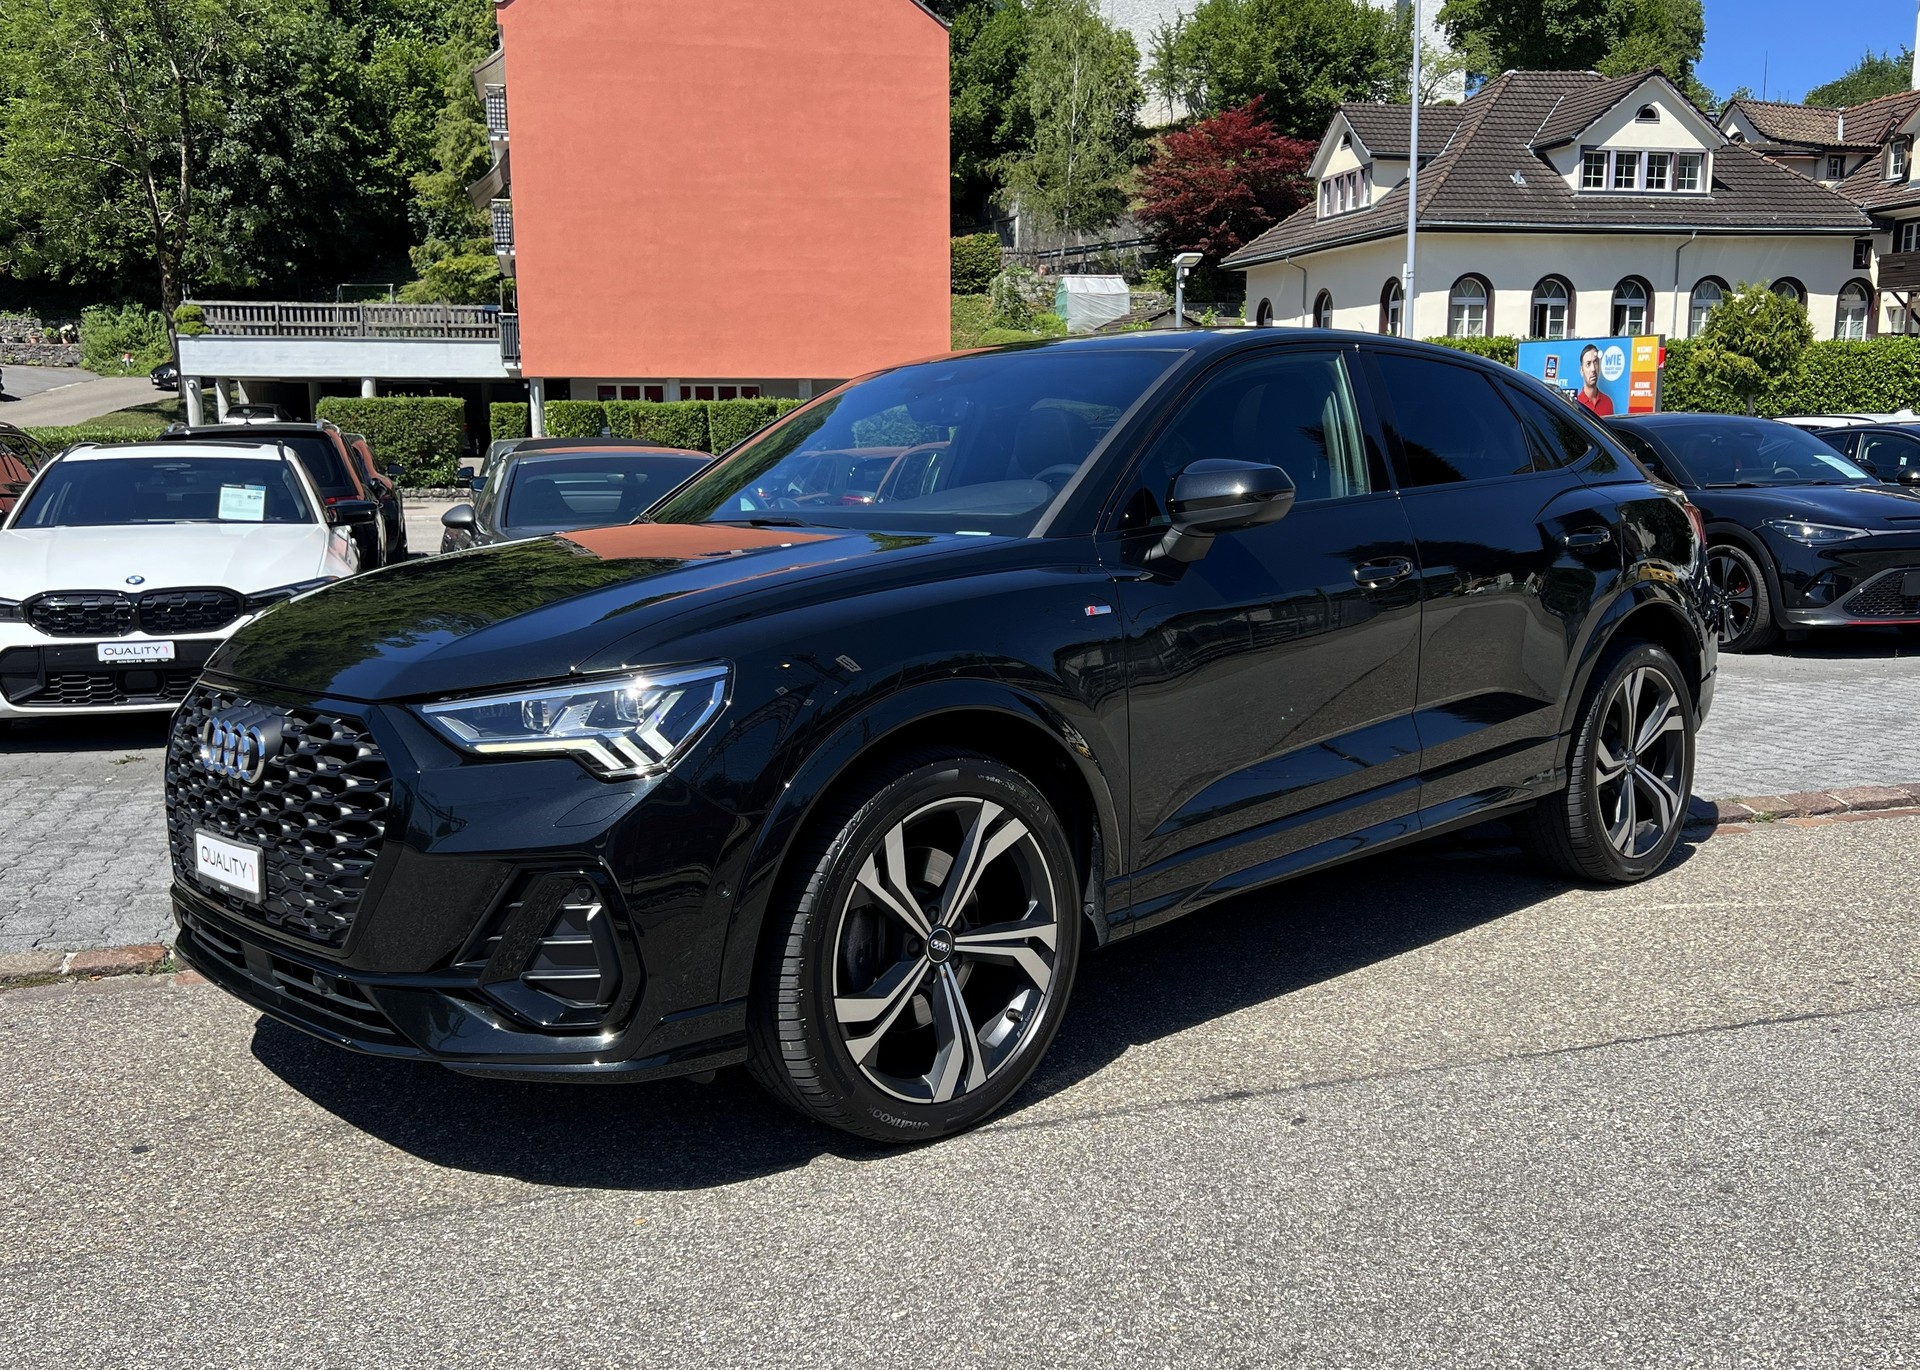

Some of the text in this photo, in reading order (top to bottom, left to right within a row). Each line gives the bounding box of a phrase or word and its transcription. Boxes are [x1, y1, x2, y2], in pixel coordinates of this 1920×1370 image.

[1605, 354, 1622, 366] WIE
[104, 646, 169, 656] QUALITY 1
[201, 845, 255, 882] QUALITY 1
